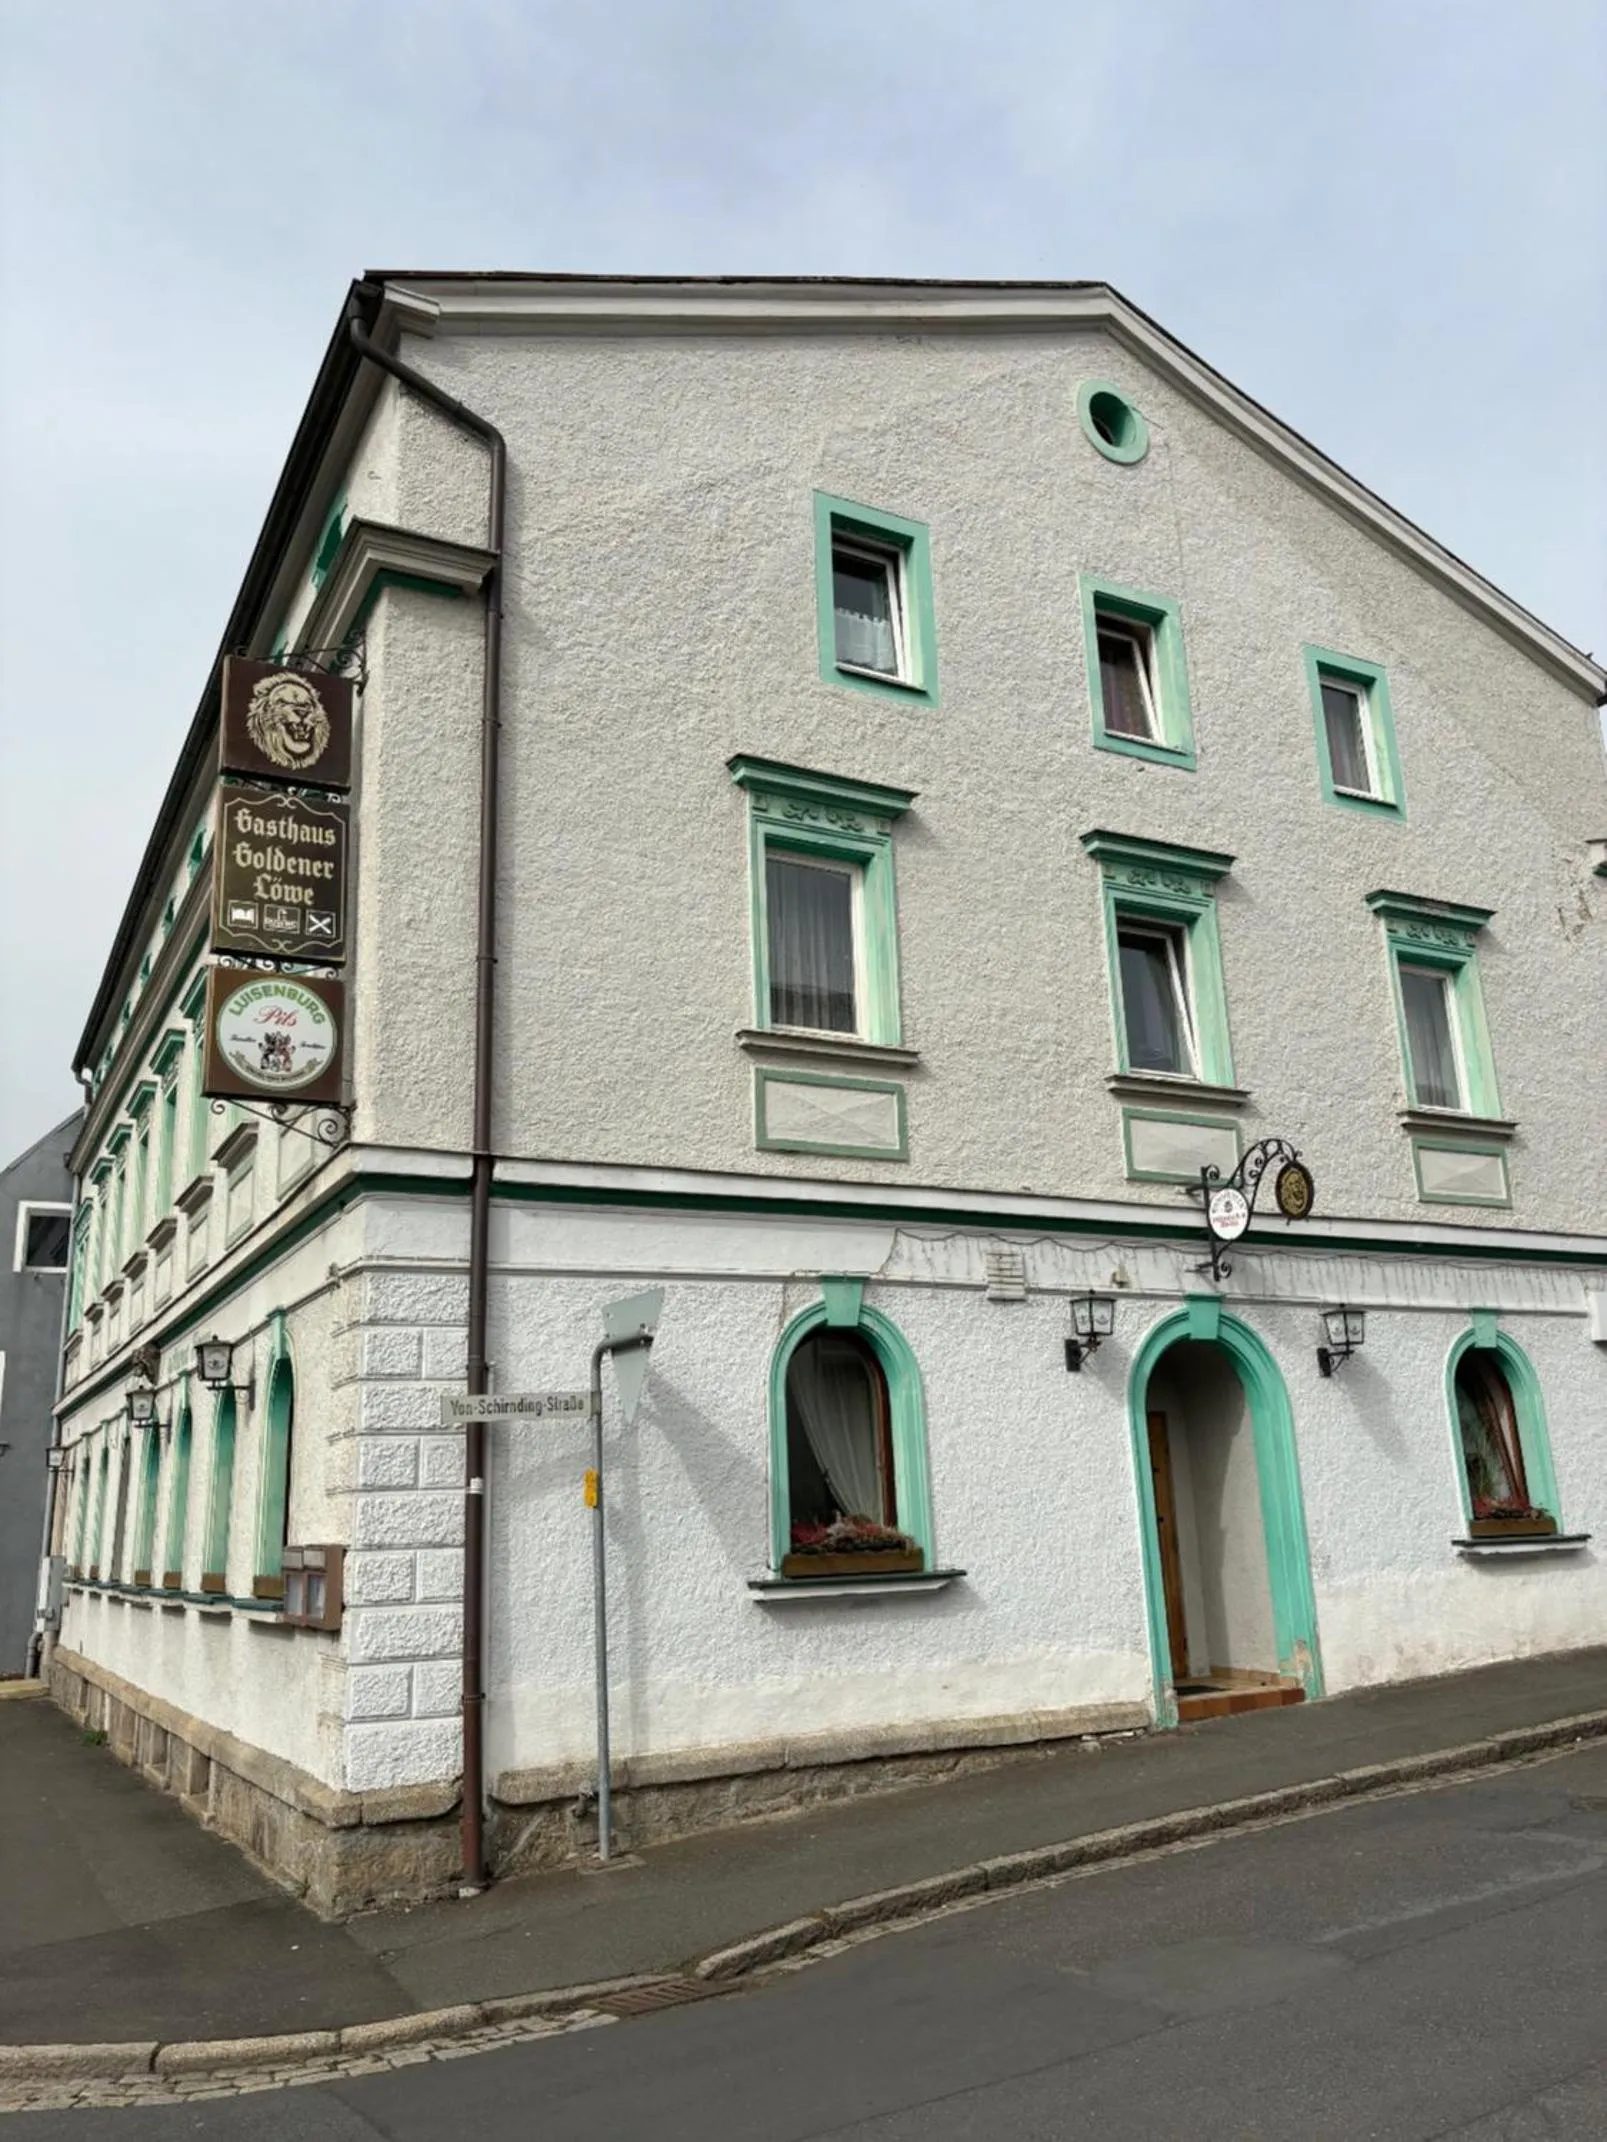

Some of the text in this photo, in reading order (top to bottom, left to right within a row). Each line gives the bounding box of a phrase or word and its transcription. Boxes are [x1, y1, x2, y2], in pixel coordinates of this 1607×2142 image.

[235, 808, 336, 846] Gasthaus
[233, 841, 335, 879] Goldener
[254, 873, 314, 905] Löwe
[229, 984, 327, 1025] LUISENBURG
[253, 1004, 297, 1027] Pils
[450, 1395, 584, 1416] Von-Schirnding-Straße
